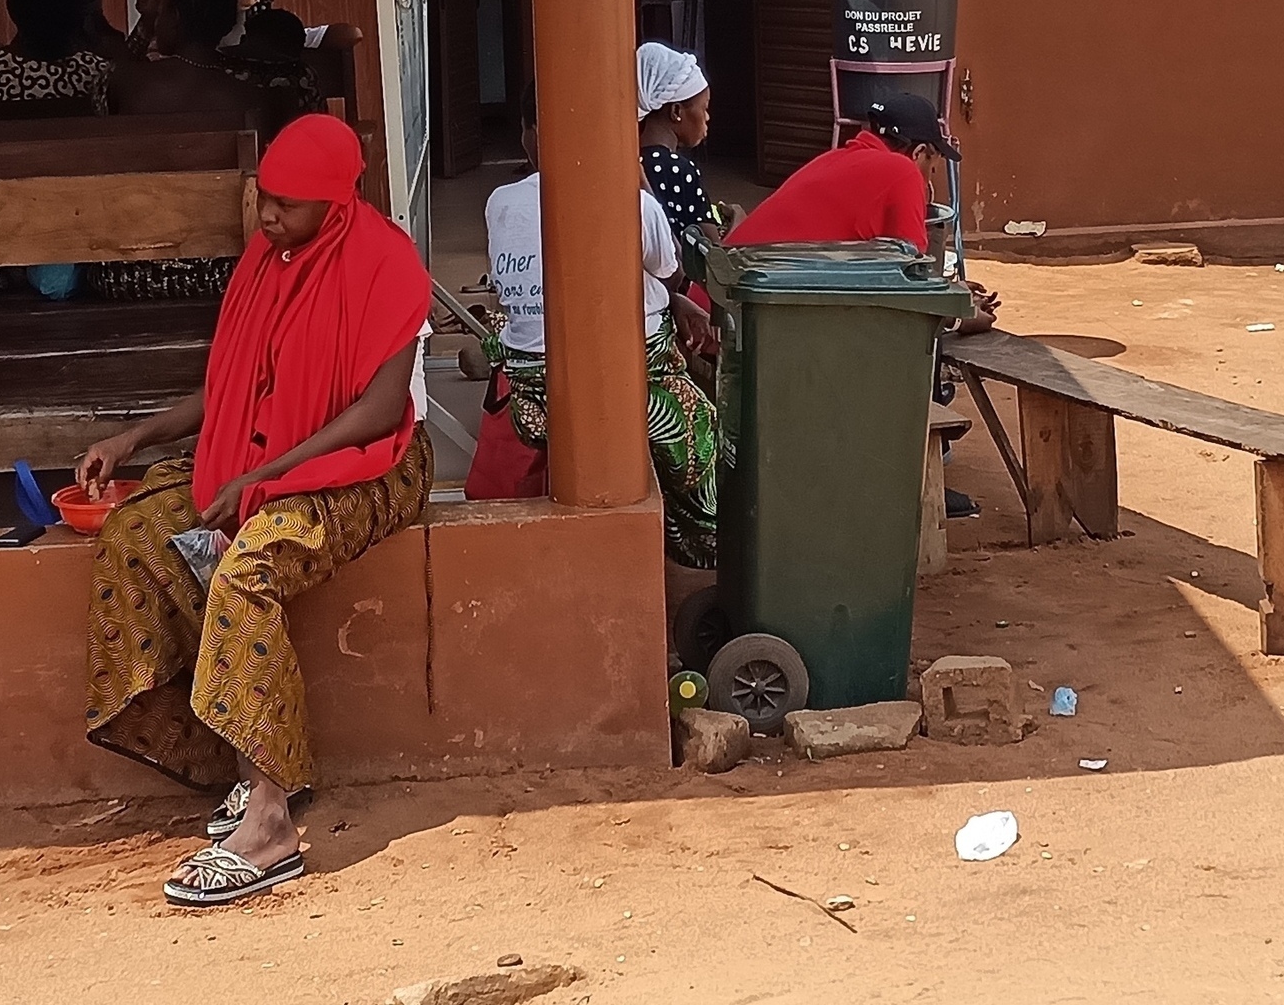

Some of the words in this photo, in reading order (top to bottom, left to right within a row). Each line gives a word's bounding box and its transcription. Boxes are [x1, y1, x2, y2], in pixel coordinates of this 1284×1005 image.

[845, 10, 863, 21] DON
[865, 11, 879, 21] DU
[881, 10, 922, 21] PROJET
[496, 252, 536, 276] Cher
